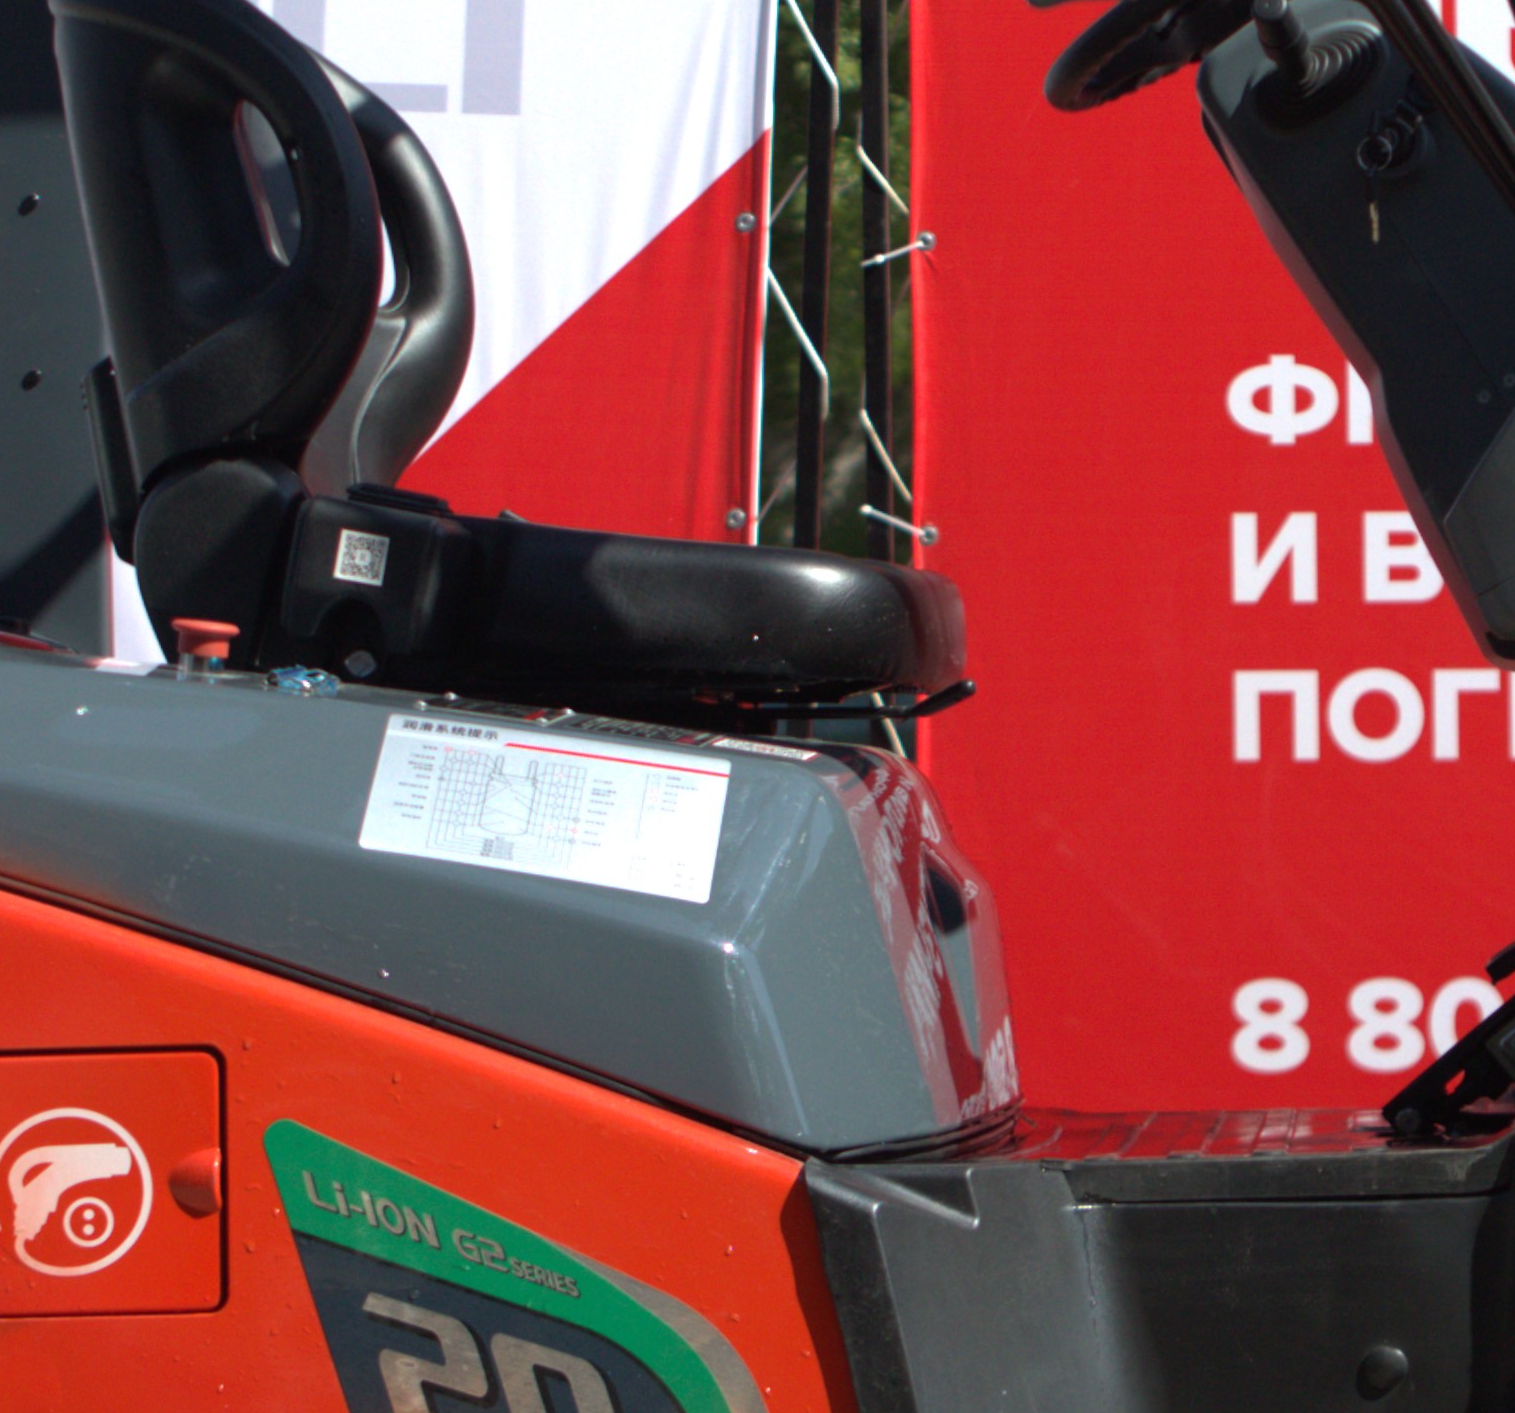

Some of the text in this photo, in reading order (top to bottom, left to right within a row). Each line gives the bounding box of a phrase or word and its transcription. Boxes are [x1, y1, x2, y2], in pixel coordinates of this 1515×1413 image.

[1230, 509, 1318, 605] И
[1230, 976, 1311, 1074] 8
[451, 1228, 510, 1274] G2
[509, 1256, 581, 1298] SERIES
